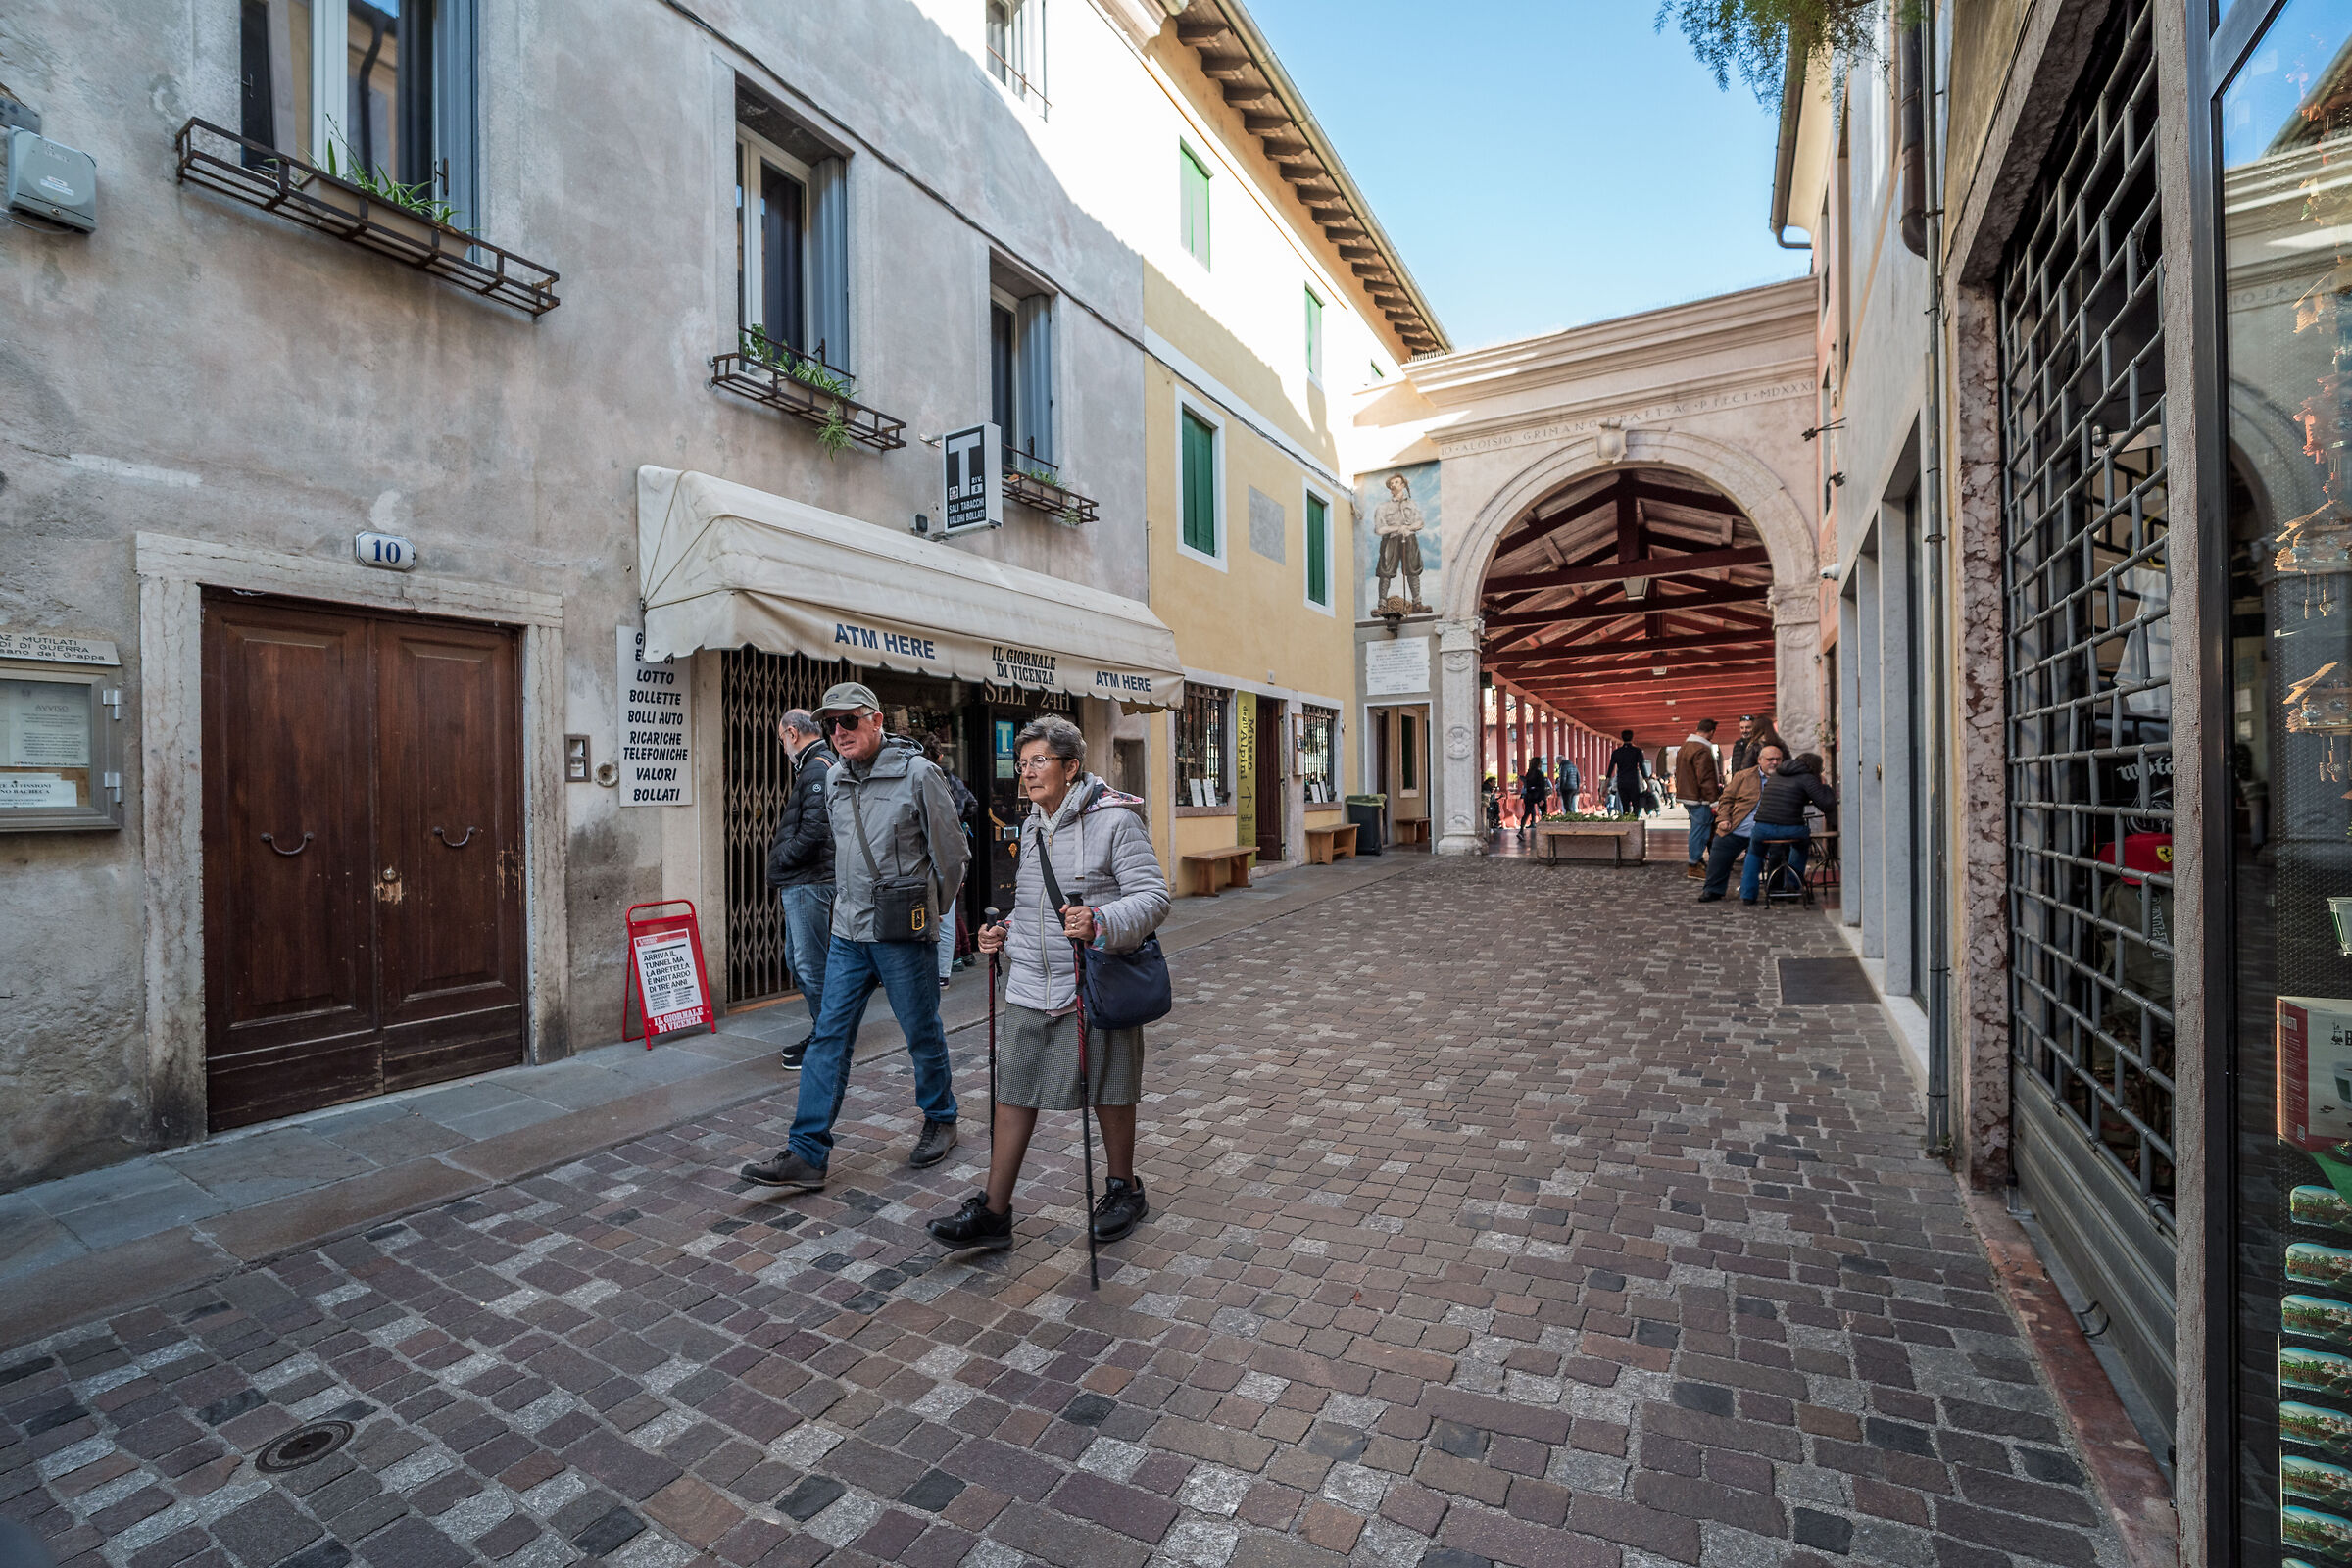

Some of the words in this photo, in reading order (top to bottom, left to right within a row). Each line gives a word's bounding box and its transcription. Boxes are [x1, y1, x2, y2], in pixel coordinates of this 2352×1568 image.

[947, 431, 981, 498] T
[949, 503, 959, 514] SALI
[960, 497, 985, 511] TABACCHI
[949, 513, 965, 524] VALORI
[965, 509, 986, 521] BOLLATI
[373, 539, 401, 564] 10
[23, 636, 77, 646] MUTILATI
[39, 644, 89, 653] GUERRA
[834, 623, 878, 650] ATM
[883, 632, 936, 660] HERE
[63, 653, 106, 662] Grappa
[992, 646, 1004, 662] IL
[1006, 649, 1056, 670] GIORNALE
[636, 669, 675, 685] LOTTO
[996, 662, 1008, 679] DI
[1011, 665, 1055, 686] VICENZA
[1096, 671, 1120, 688] ATM
[1122, 674, 1152, 693] HERE
[629, 689, 682, 706] BOLLETTE
[628, 710, 657, 724] BOLLI
[659, 711, 683, 725] AUTO
[629, 730, 682, 746] RICARICHE
[623, 746, 688, 761] TELEFONICHE
[1239, 729, 1248, 780] Alpini
[636, 767, 677, 782] VALORI
[633, 788, 681, 802] BOLLATI
[643, 952, 669, 961] ARRIVA
[645, 959, 672, 970] TUNNEL
[672, 956, 684, 964] MA
[646, 969, 656, 978] LA
[656, 962, 691, 976] BRETELLA
[661, 969, 691, 983] RITARDO
[671, 978, 688, 988] ANNI
[654, 1016, 663, 1026] IL
[663, 1007, 704, 1023] GIORNALE
[658, 1023, 668, 1033] DI
[668, 1015, 703, 1030] VICENZA
